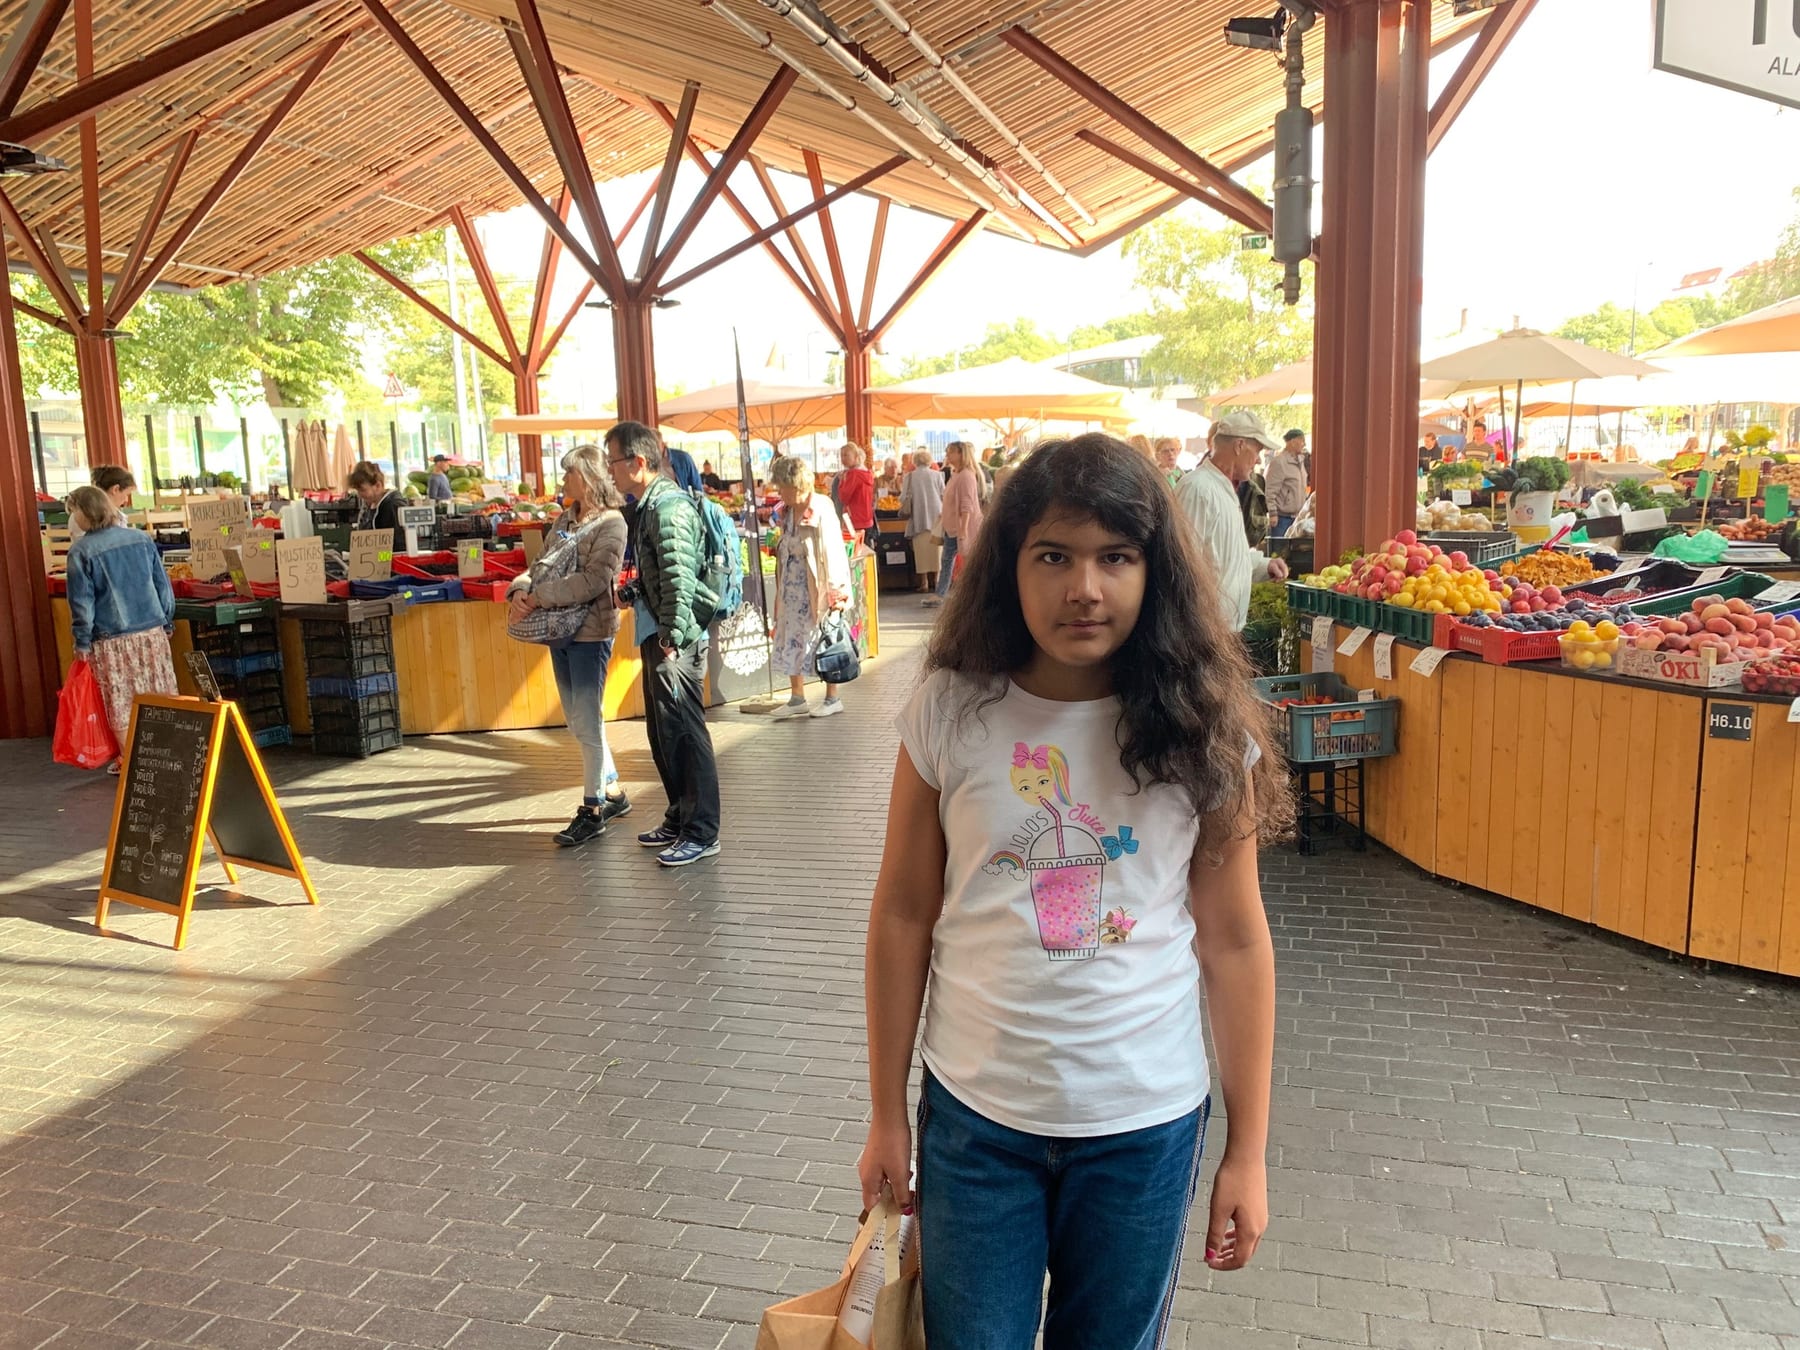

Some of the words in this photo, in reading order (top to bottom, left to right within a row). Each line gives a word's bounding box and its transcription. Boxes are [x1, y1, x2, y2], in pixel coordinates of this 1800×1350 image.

[286, 565, 299, 588] 5
[356, 552, 375, 578] 5
[1709, 713, 1752, 730] H6.10
[1009, 811, 1049, 853] JOJO'S
[1068, 802, 1106, 834] Juice
